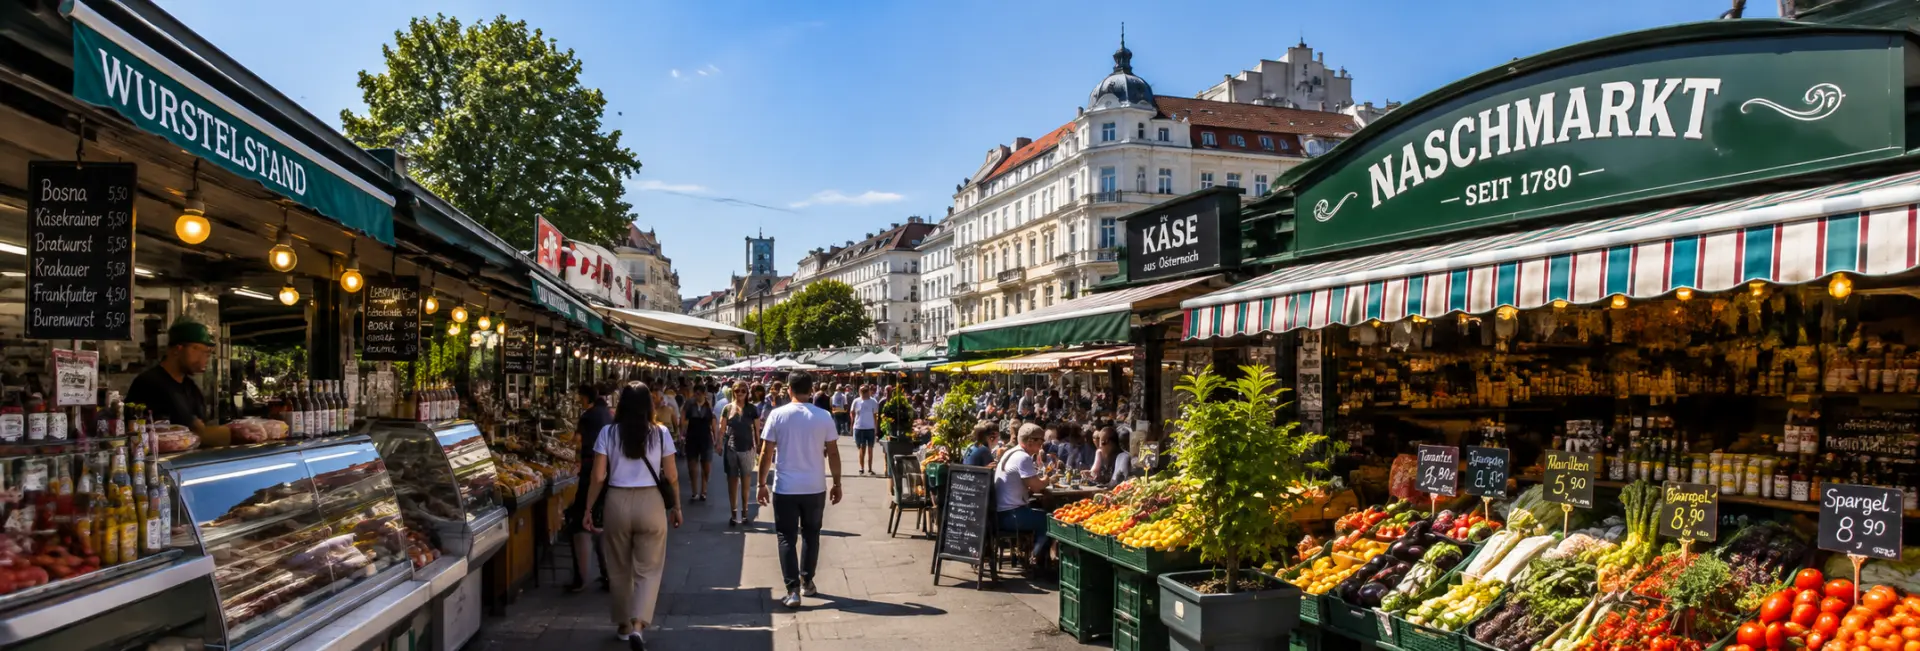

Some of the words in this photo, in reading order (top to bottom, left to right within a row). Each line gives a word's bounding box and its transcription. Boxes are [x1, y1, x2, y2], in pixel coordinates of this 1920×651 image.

[98, 48, 307, 196] WURSTELSTAND
[1369, 77, 1722, 208] NASCHMARKT
[41, 178, 88, 202] Bosna
[1465, 181, 1511, 206] SEIT
[1520, 165, 1572, 196] 1780
[35, 207, 102, 227] Käsekrainer
[35, 232, 93, 252] Bratwurst
[35, 257, 90, 277] Krakauer
[1143, 263, 1156, 272] aus
[105, 286, 127, 305] 4,50
[33, 308, 95, 328] Burenwurst
[1824, 488, 1890, 515] Spargel
